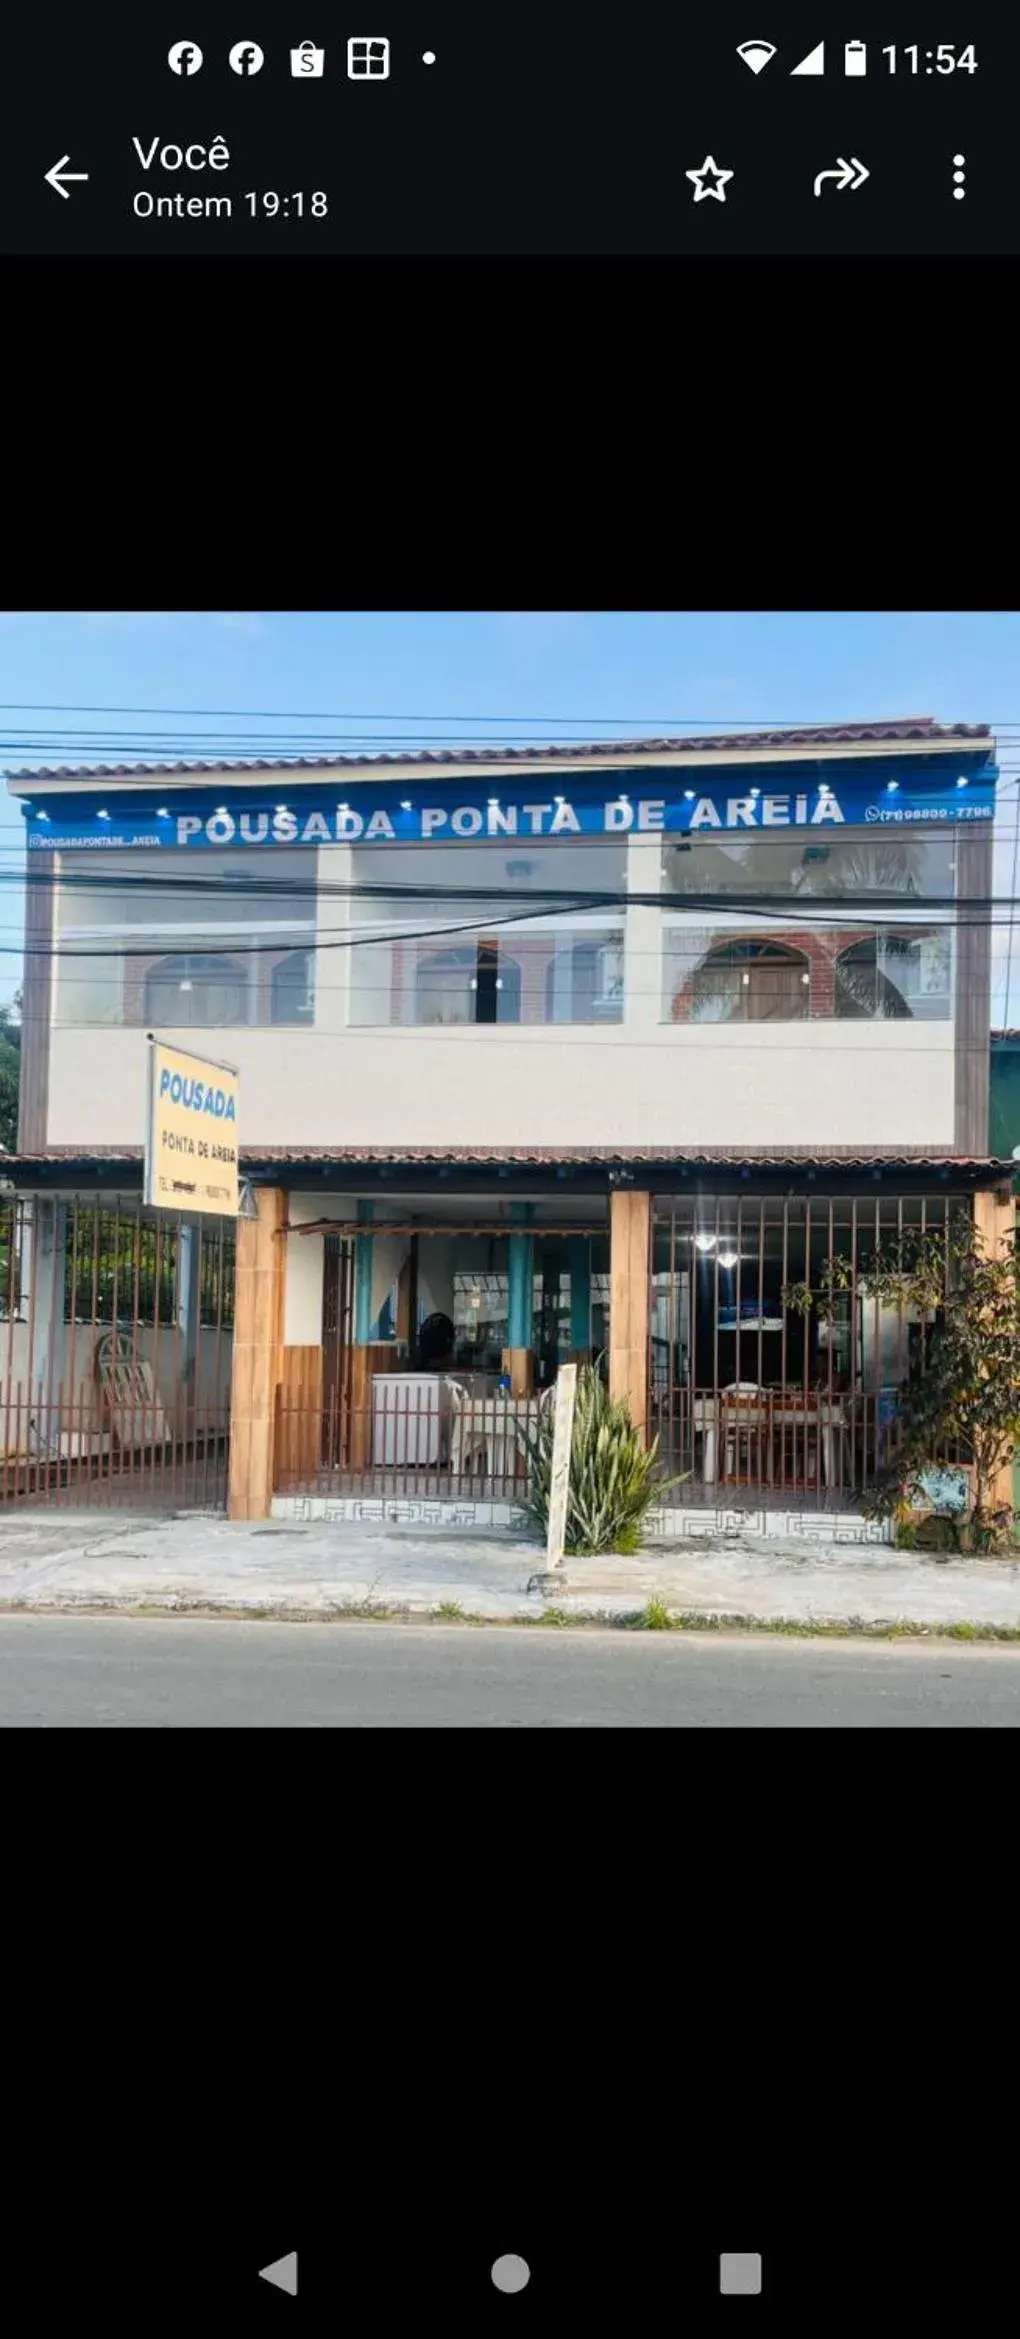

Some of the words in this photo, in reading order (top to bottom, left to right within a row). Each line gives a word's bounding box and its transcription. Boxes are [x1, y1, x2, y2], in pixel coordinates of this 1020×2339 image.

[177, 810, 396, 844] POUSADA
[421, 804, 581, 837] PONTA
[604, 799, 666, 831] DE
[689, 793, 846, 828] AREIA
[159, 1067, 236, 1122] POUSADA
[162, 1130, 195, 1156] PONTA
[197, 1140, 209, 1159] DE
[211, 1143, 236, 1164] AREIA
